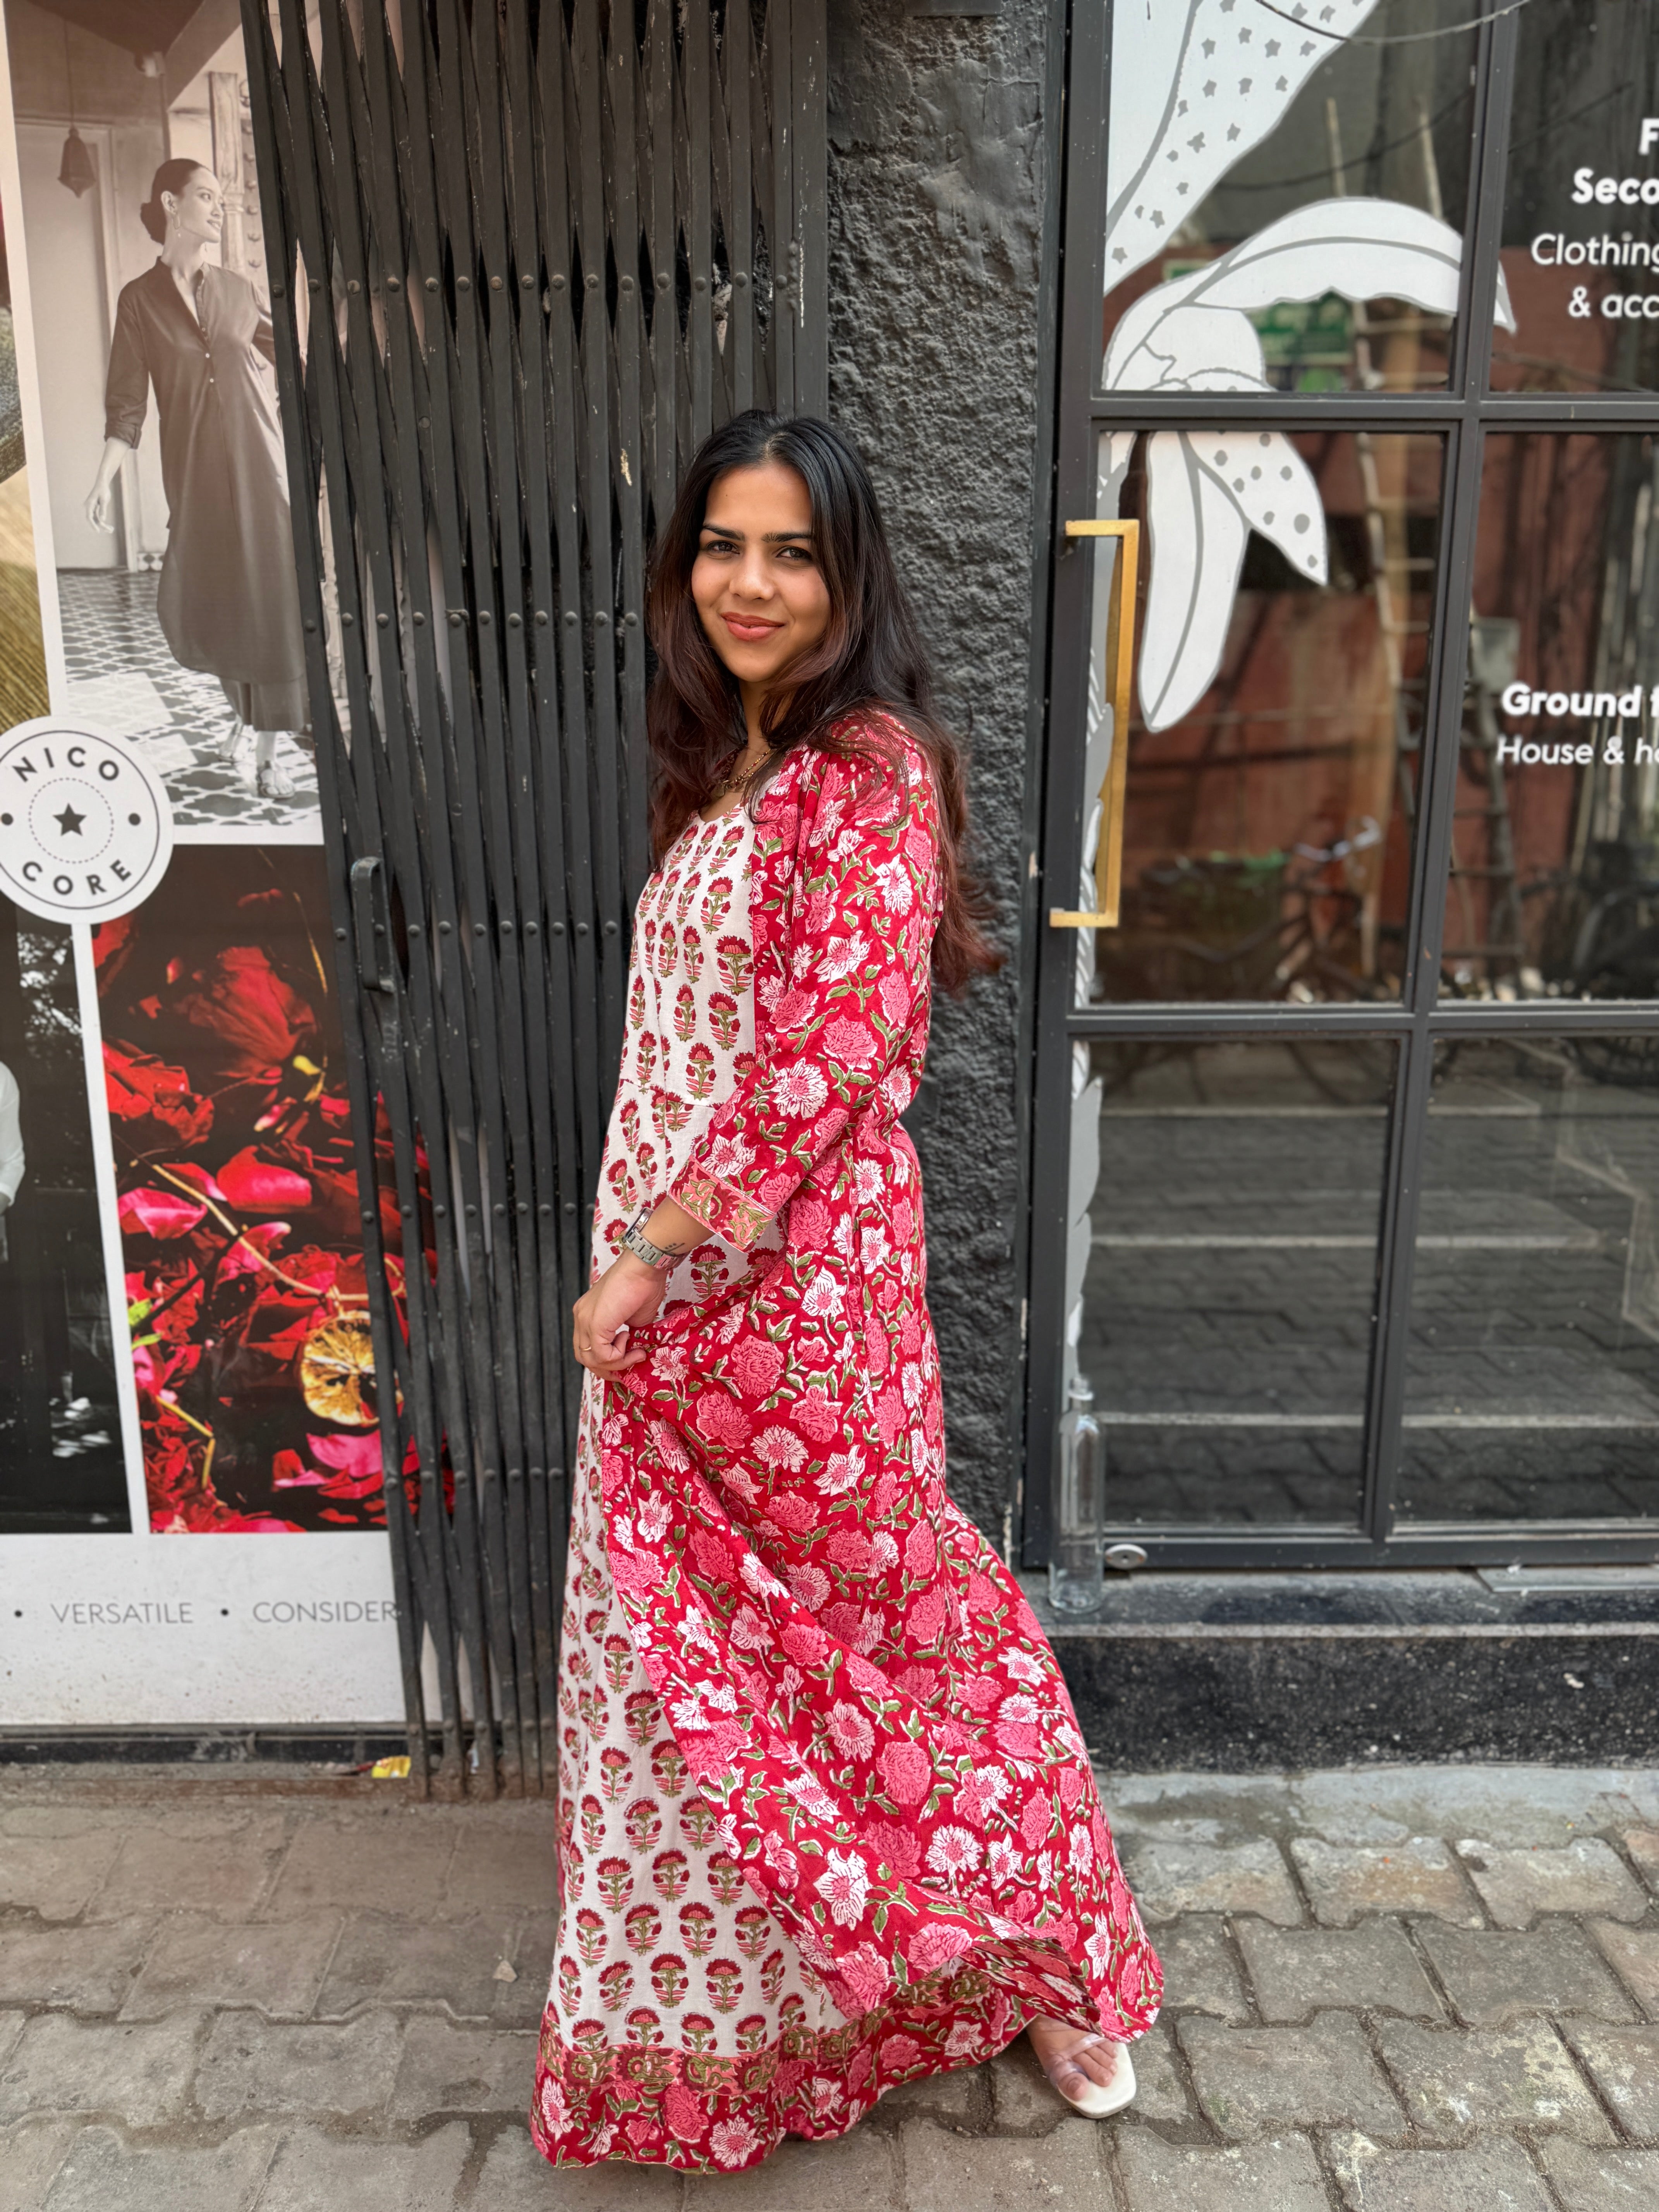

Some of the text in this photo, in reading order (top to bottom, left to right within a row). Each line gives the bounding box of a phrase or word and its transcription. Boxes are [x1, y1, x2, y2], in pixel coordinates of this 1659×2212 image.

[1571, 167, 1659, 204] Seco
[1568, 286, 1659, 318] & acc
[1501, 682, 1642, 717] Ground
[12, 746, 119, 783] NICO
[1496, 735, 1659, 764] House & h
[22, 859, 132, 895] CORE
[50, 1601, 397, 1625] VERSATILE CONSIDER
